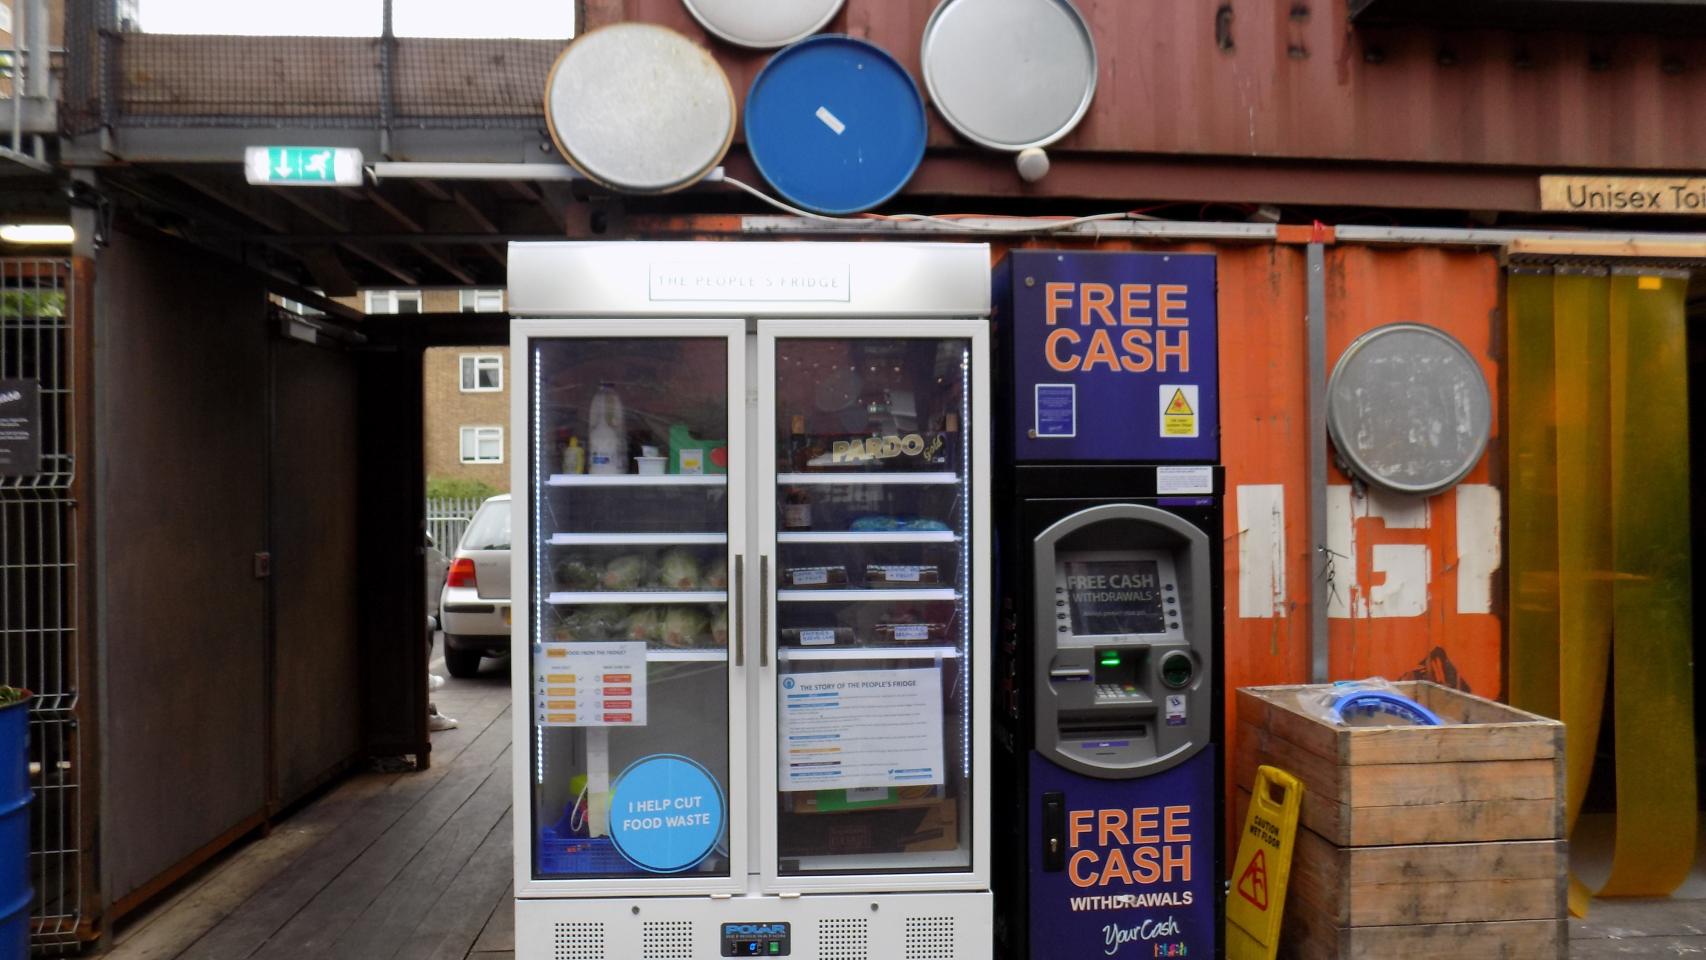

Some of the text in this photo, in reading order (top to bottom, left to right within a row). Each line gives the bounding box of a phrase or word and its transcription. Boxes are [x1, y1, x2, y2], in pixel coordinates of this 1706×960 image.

[1567, 184, 1661, 209] Unisex
[657, 274, 840, 289] THE PEOPLES FRIDGE
[1045, 282, 1189, 327] FREE
[1045, 327, 1189, 373] CASH
[832, 433, 925, 463] PARDO
[1067, 575, 1153, 589] FREE CASH
[1072, 591, 1153, 603] WITHDRAWALS
[814, 683, 836, 691] STORY
[861, 680, 892, 688] PEOPLE'S
[892, 680, 916, 688] FRIDGE
[628, 795, 702, 813] I HELP CUT
[623, 812, 711, 832] FOOD WASTE
[1068, 805, 1192, 848] FREE
[1253, 815, 1280, 837] CAUTION
[1249, 824, 1281, 850] WET FLOOR
[1068, 844, 1192, 888] CASH
[1069, 890, 1194, 912] WITHDRAWALS
[725, 924, 786, 935] POLAR
